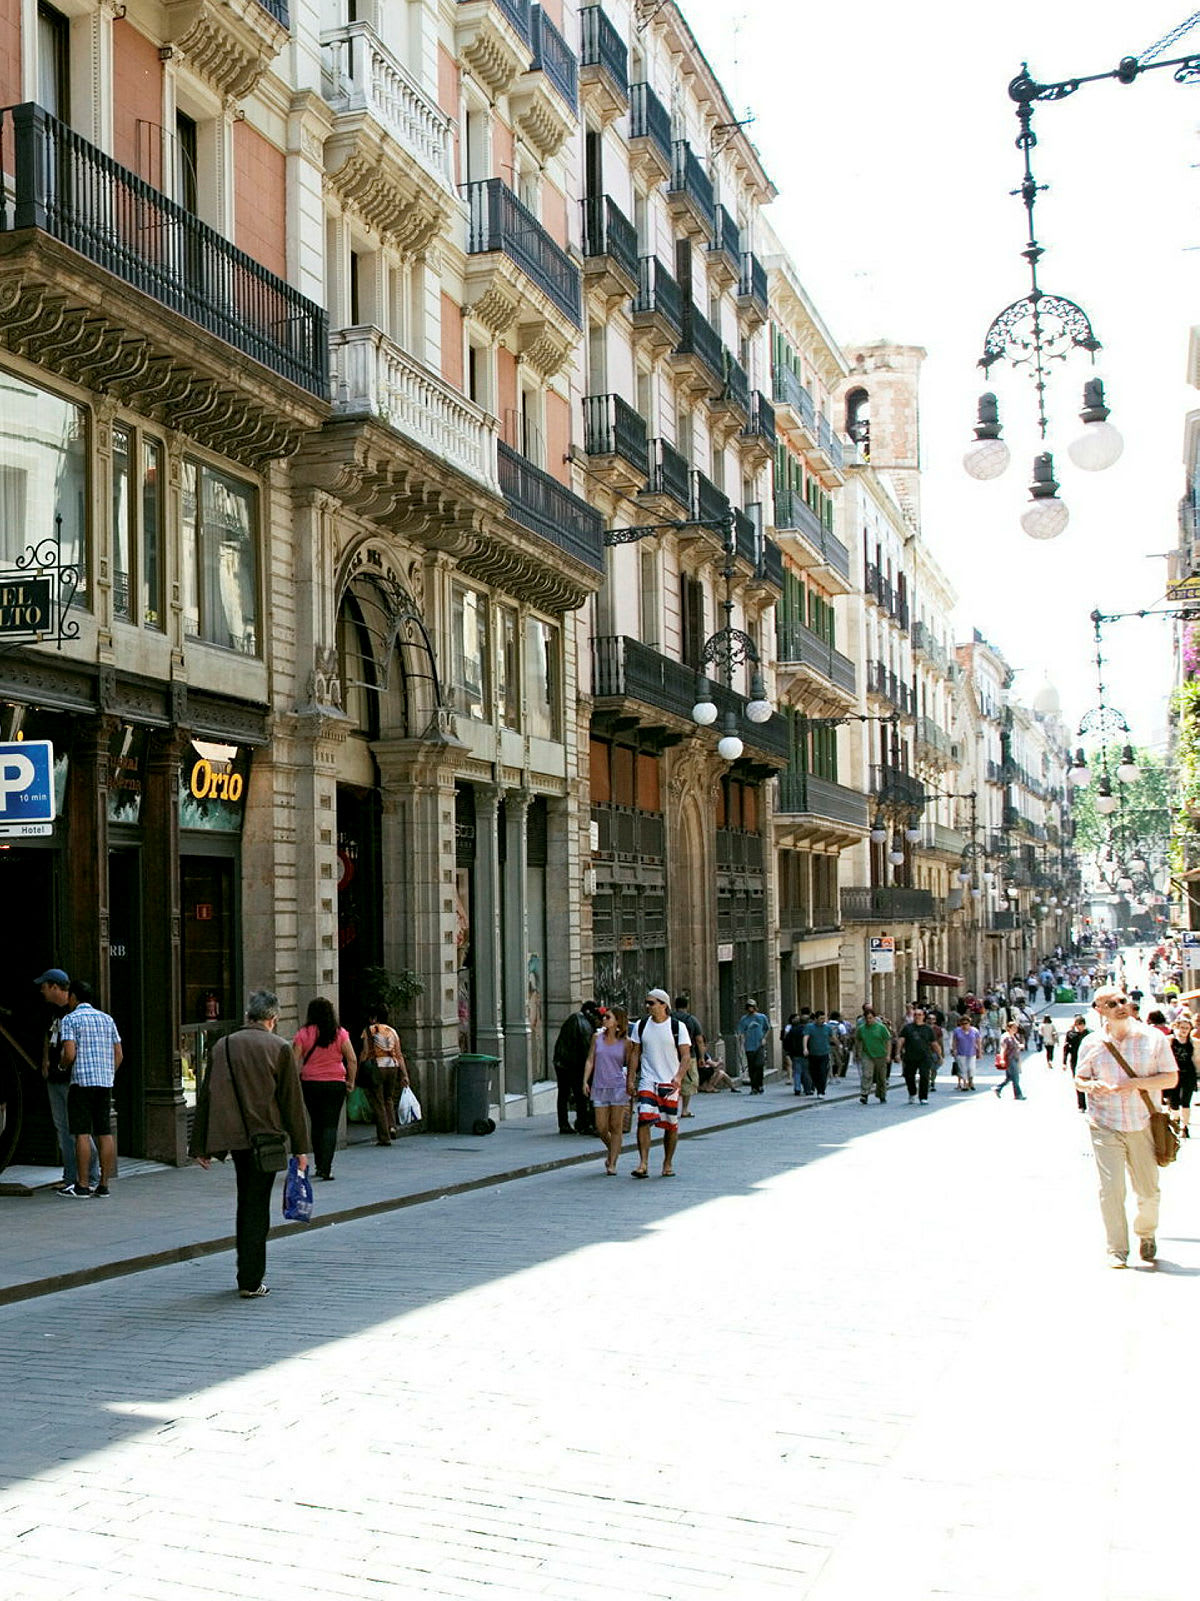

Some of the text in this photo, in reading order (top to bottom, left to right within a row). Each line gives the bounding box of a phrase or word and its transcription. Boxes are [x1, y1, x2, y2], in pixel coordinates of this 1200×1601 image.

[191, 759, 243, 801] Orio
[19, 792, 47, 803] 10 min
[21, 826, 46, 835] Hotel
